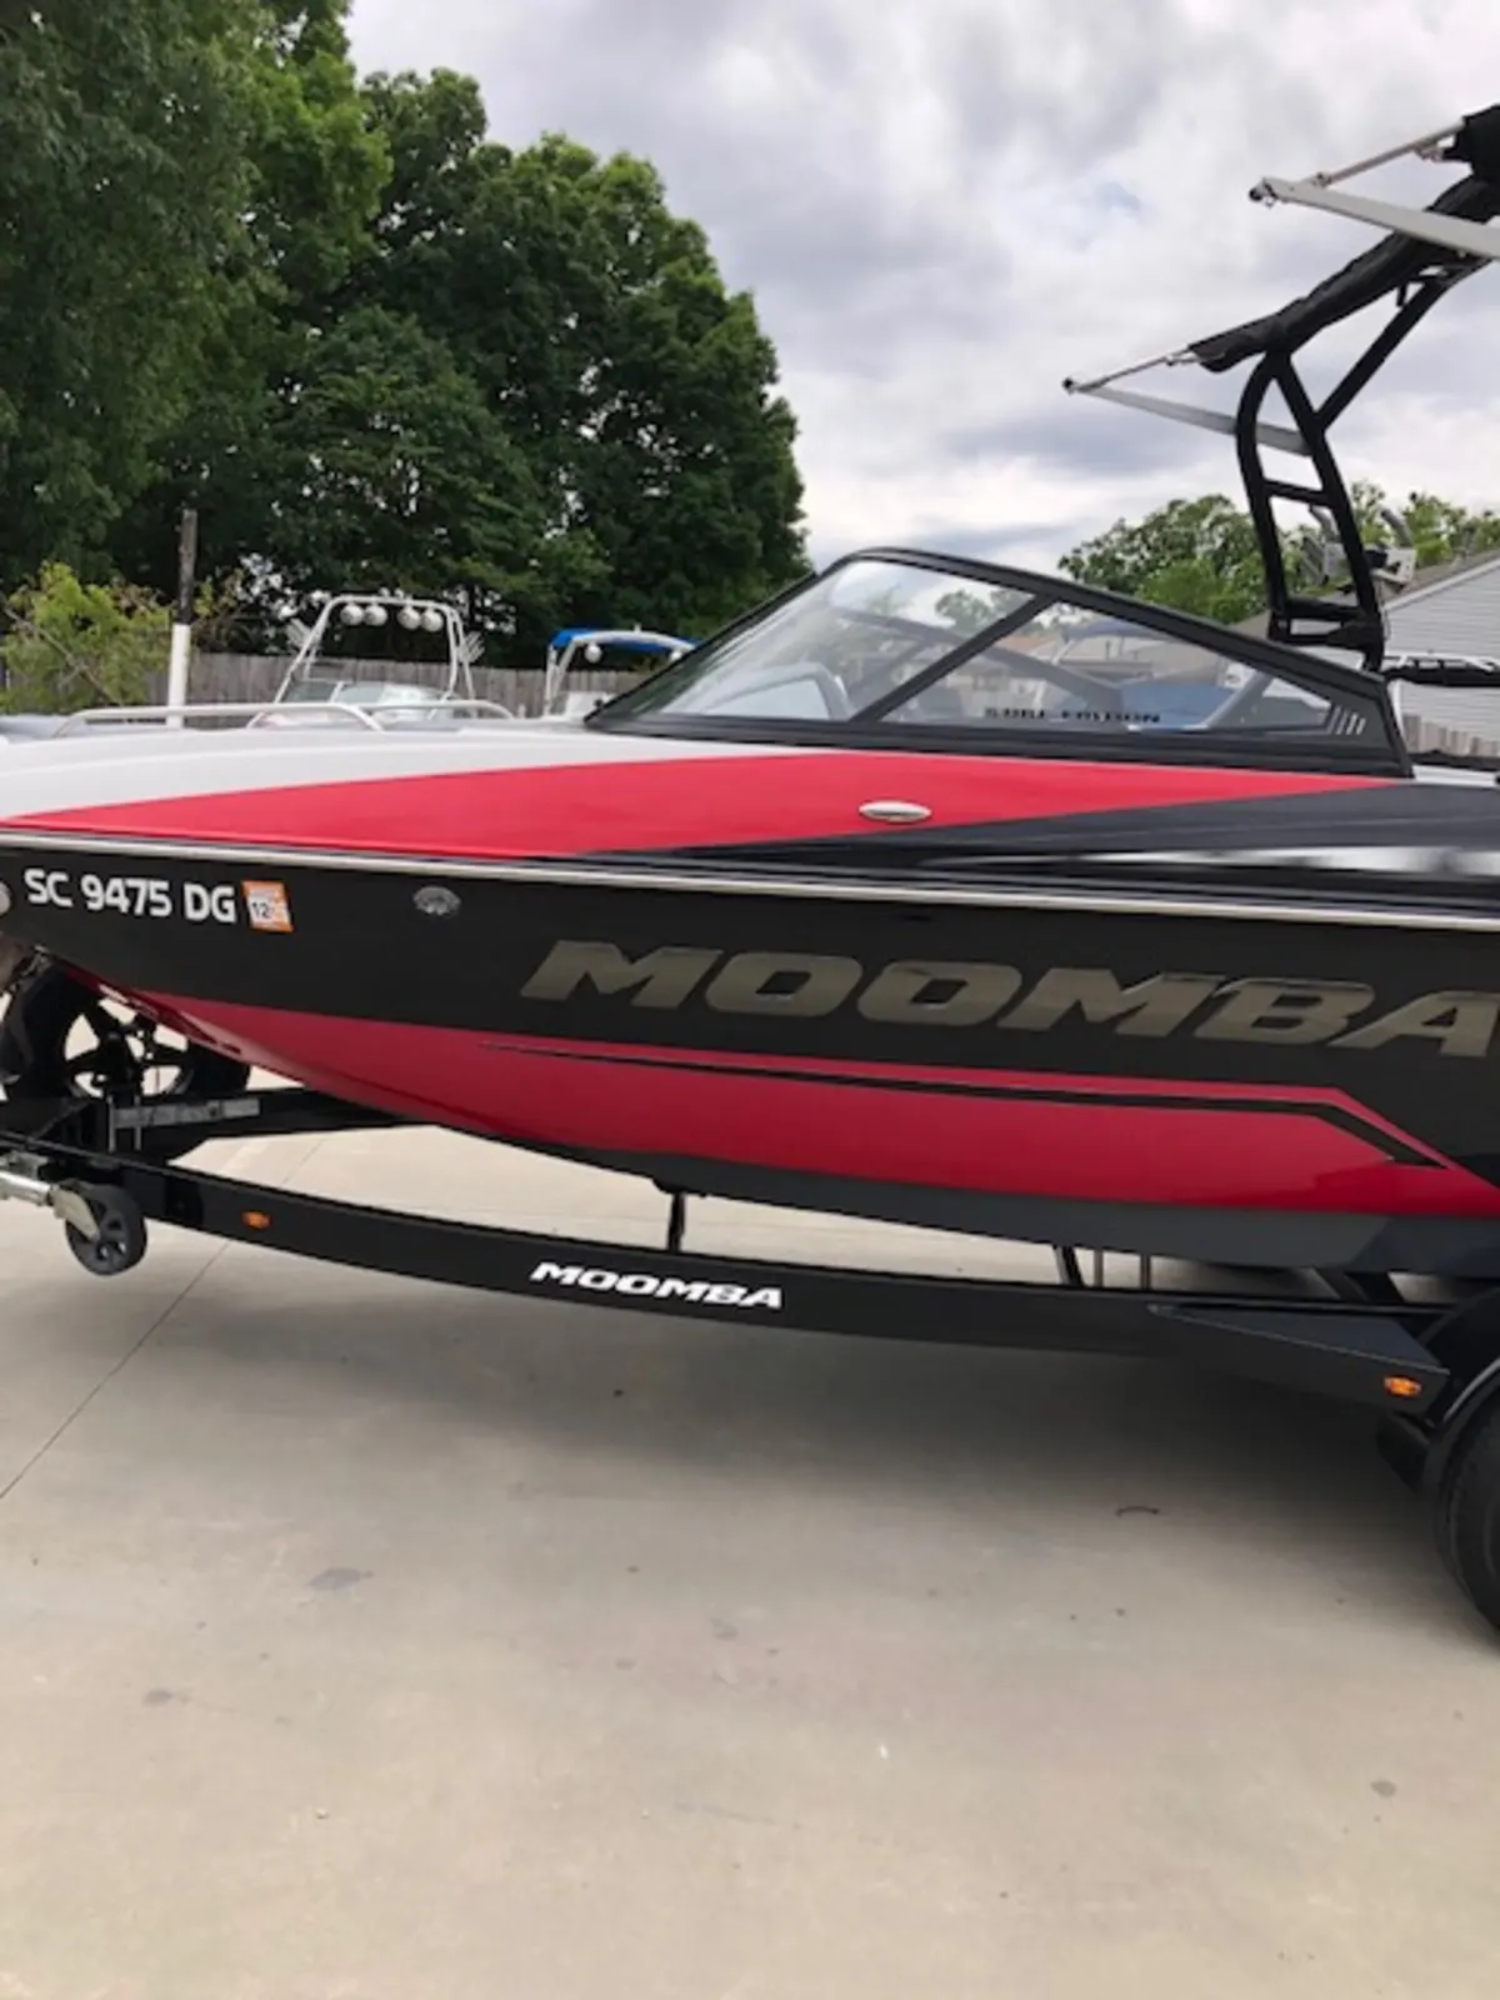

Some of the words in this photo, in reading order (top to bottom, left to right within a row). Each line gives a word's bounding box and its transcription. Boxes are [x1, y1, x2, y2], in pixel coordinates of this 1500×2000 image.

[24, 868, 74, 908] SC
[80, 874, 174, 918] 9475
[183, 882, 237, 924] DG
[520, 940, 1500, 1058] MOOMBA
[529, 1261, 783, 1310] MOOMBA
